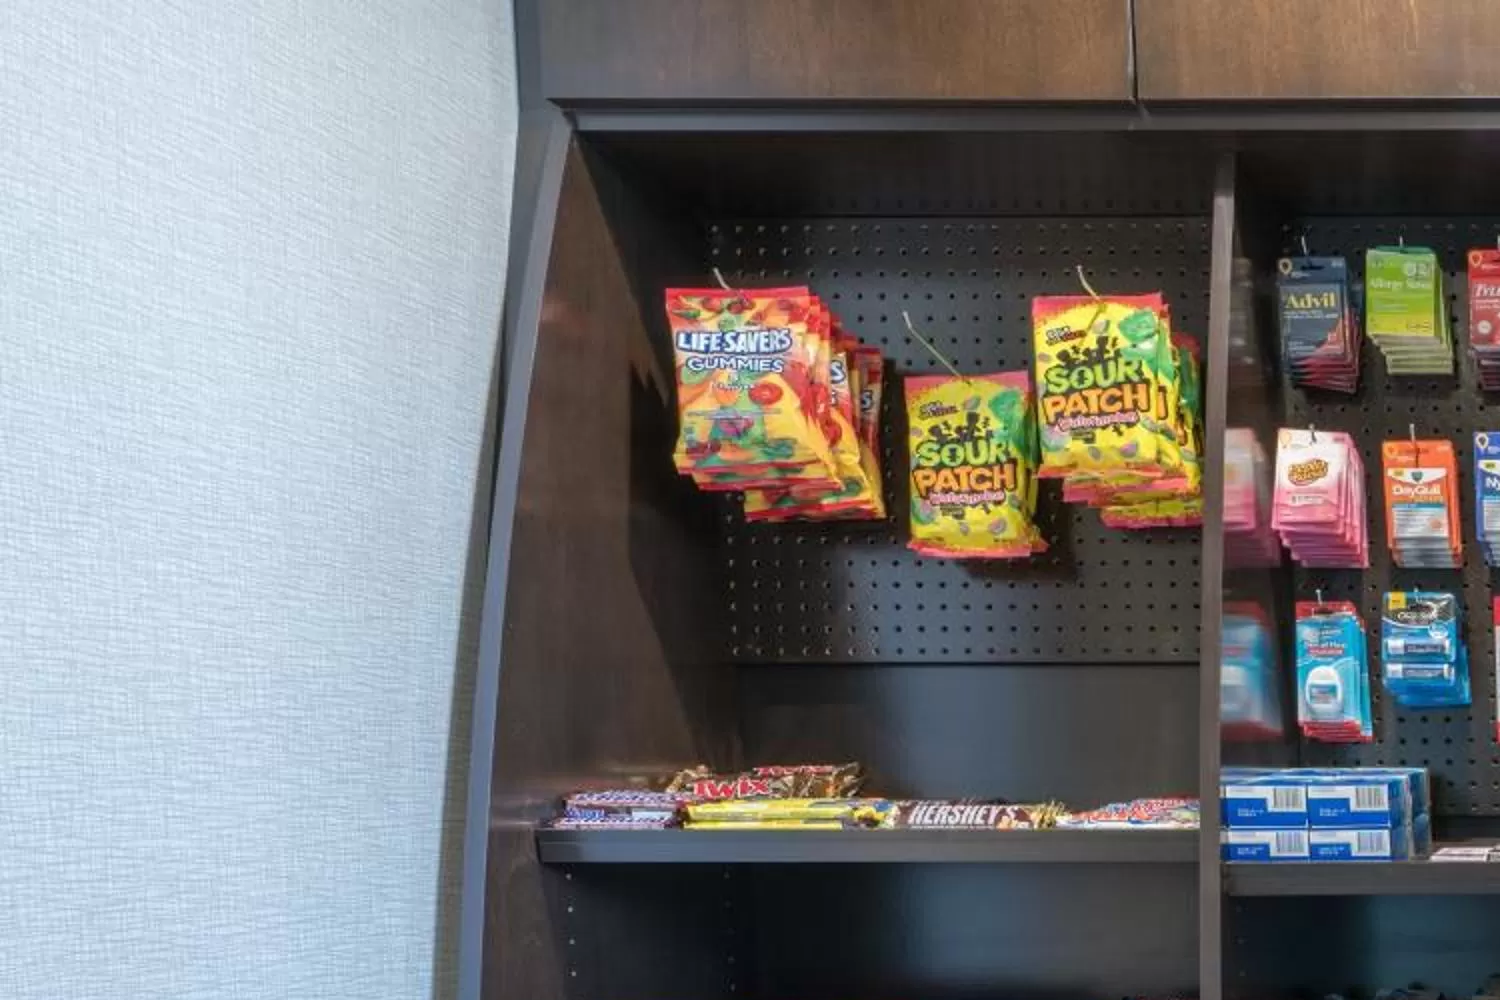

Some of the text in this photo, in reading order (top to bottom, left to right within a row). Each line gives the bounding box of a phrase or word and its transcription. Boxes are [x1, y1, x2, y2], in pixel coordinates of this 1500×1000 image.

[1284, 292, 1335, 308] Advil
[687, 356, 784, 373] GUMMIES
[1045, 358, 1142, 393] SOUR
[1043, 382, 1149, 424] PATCH
[916, 439, 1010, 467] SOUR
[913, 459, 1018, 497] PATCH
[1392, 484, 1441, 498] DayQuil
[908, 801, 1017, 826] HERSHEY'S
